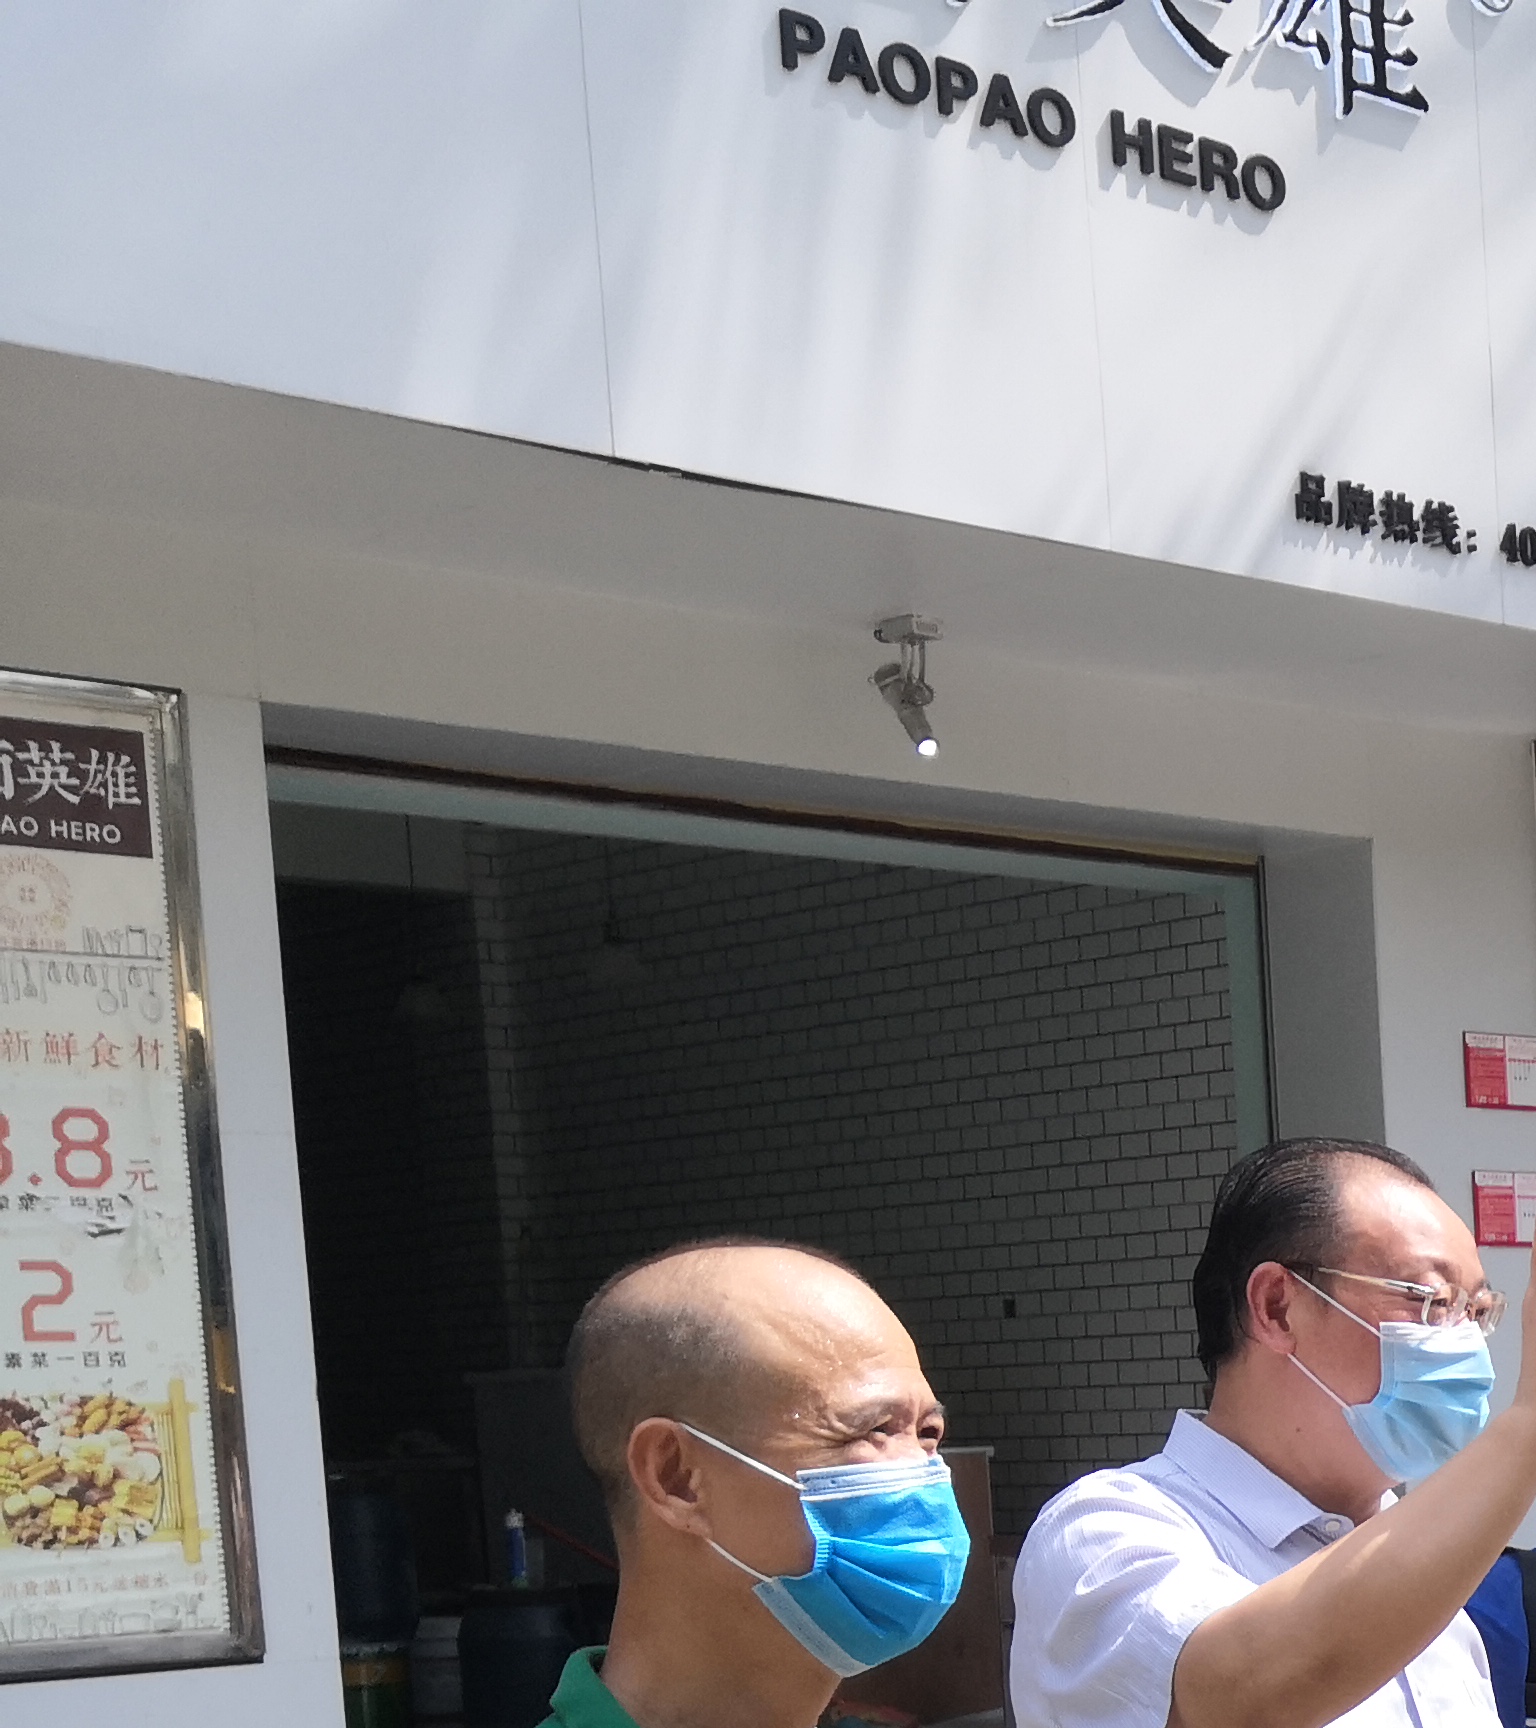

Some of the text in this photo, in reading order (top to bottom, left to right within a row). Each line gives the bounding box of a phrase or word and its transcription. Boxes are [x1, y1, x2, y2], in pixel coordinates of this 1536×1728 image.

[778, 8, 1287, 212] PAOPAO HERO
[50, 819, 122, 845] HERO
[126, 1159, 158, 1192] 元
[18, 1258, 123, 1344] 2 元
